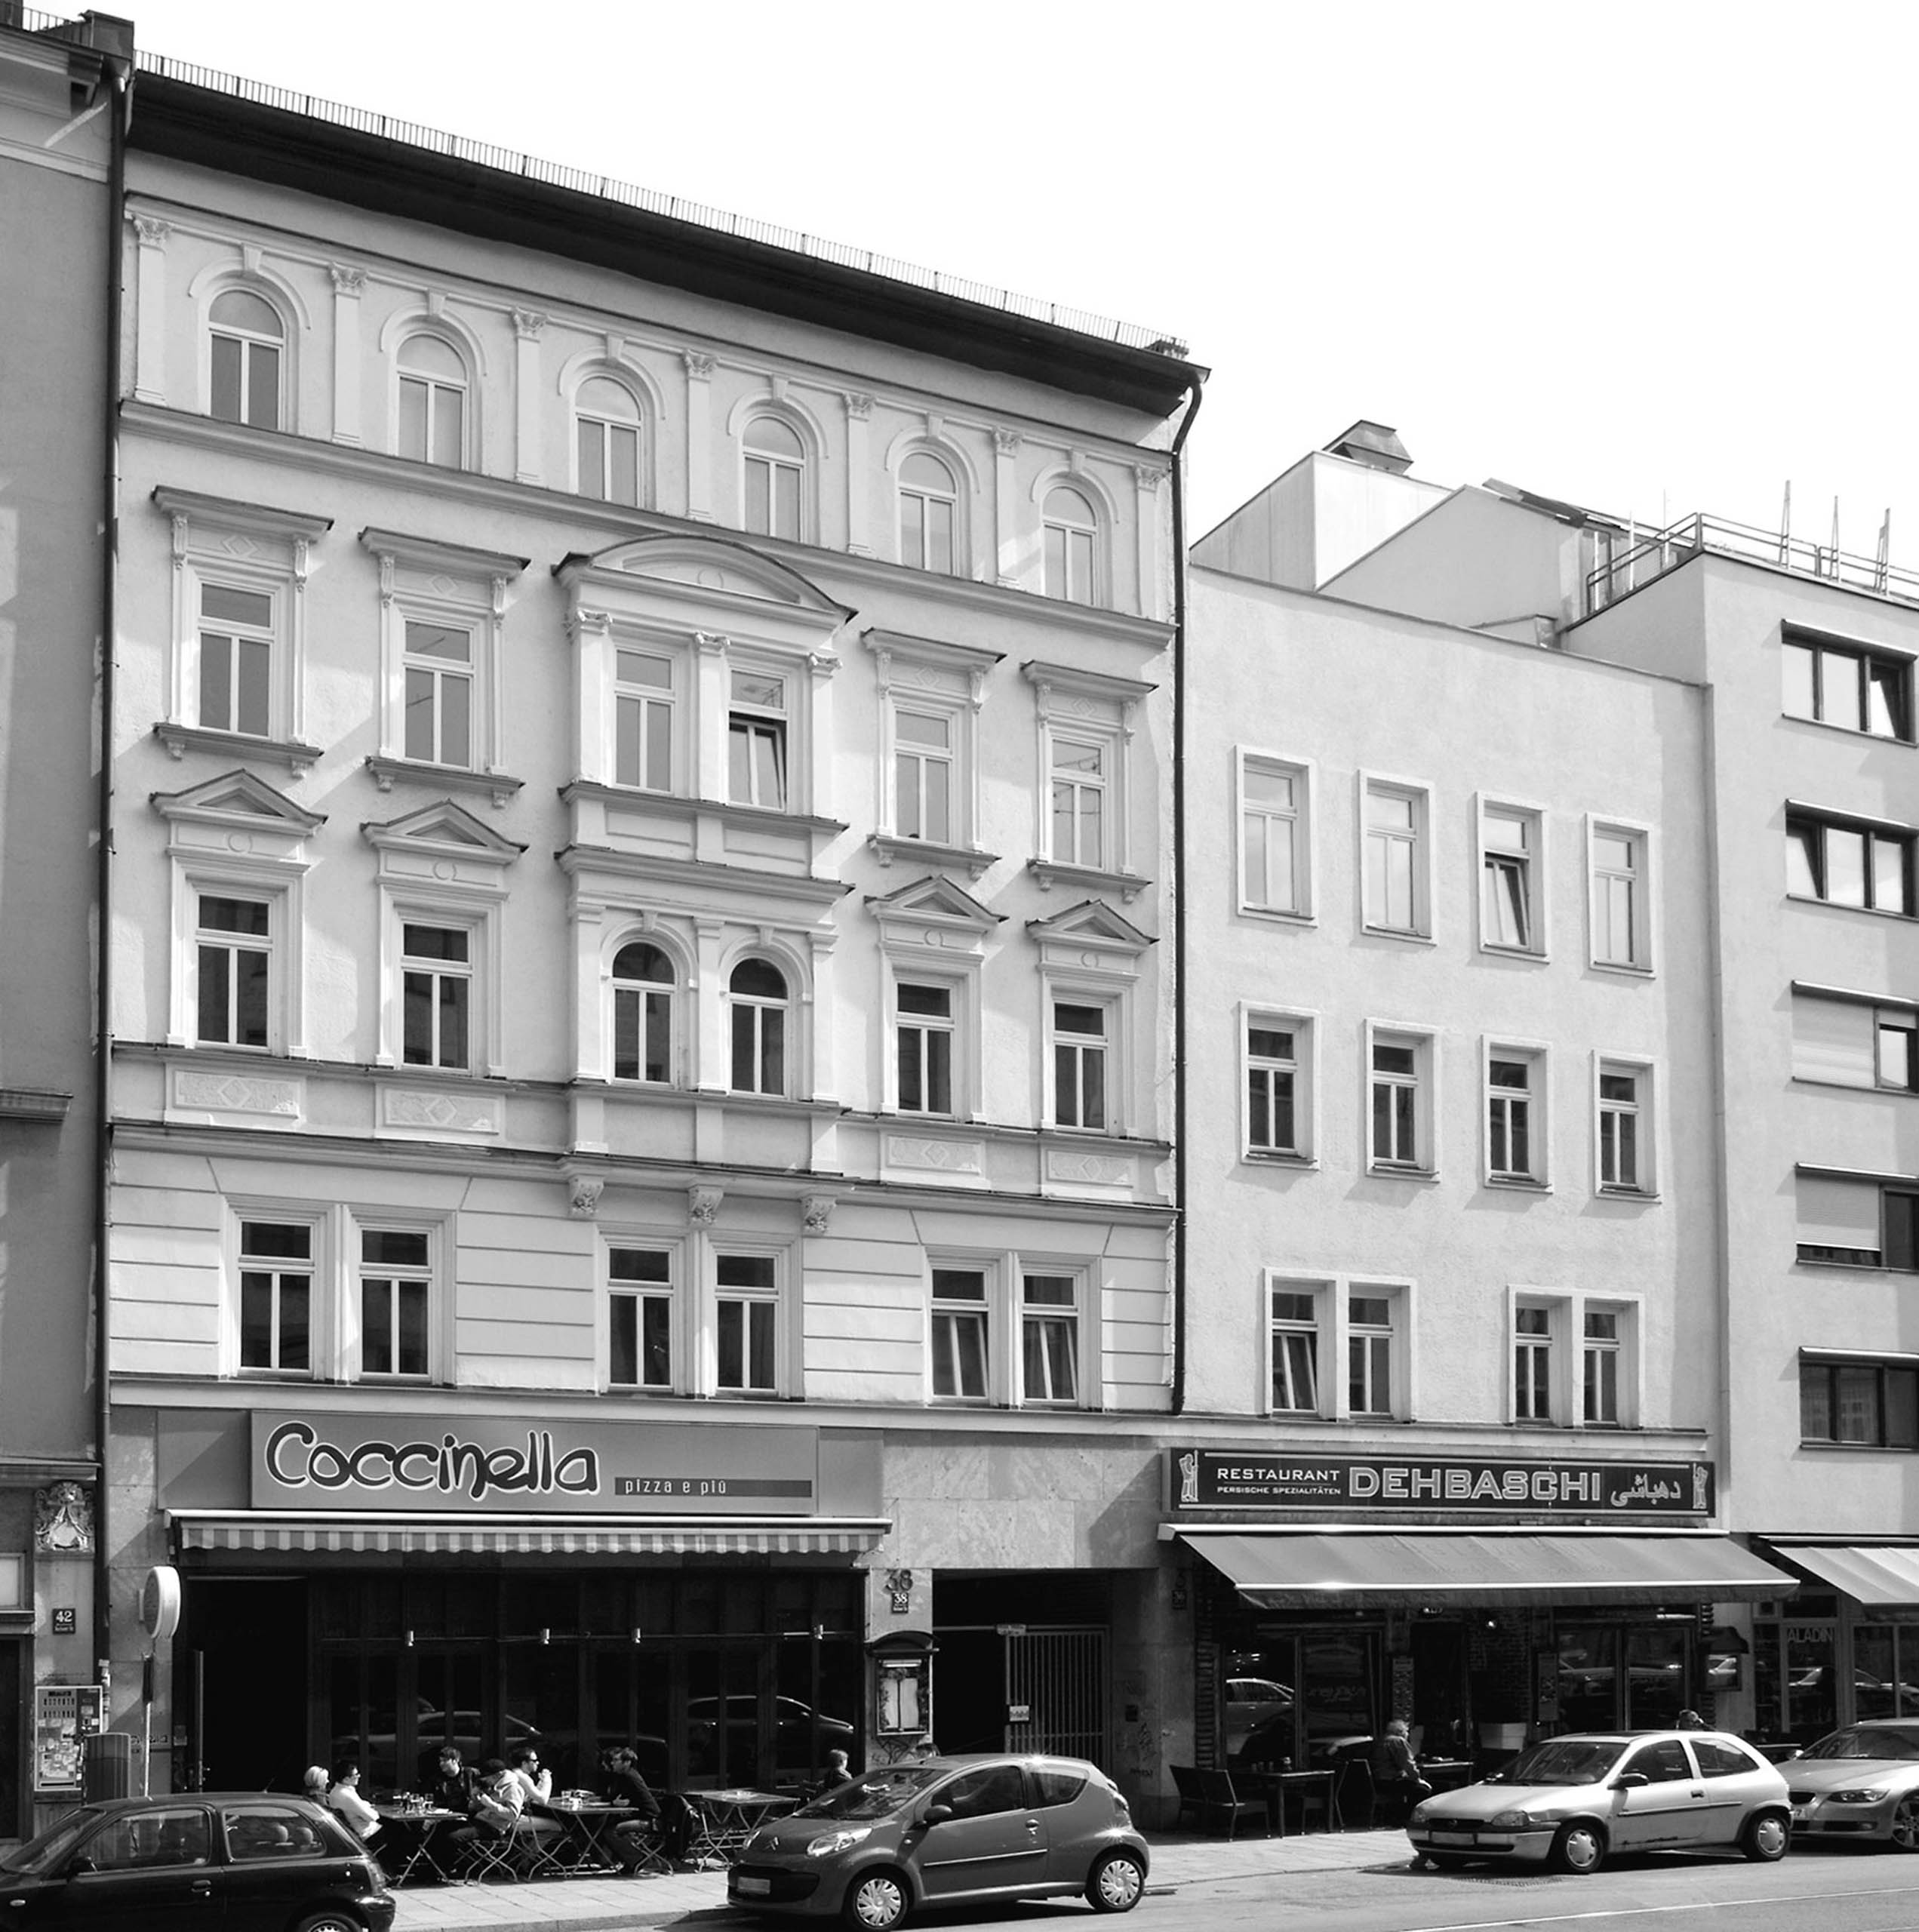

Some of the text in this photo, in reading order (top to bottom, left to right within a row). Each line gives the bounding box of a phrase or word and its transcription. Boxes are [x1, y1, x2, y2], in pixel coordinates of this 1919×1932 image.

[266, 1420, 601, 1500] Coccinella
[1217, 1468, 1340, 1481] RESTAURANT
[625, 1478, 672, 1494] pizza
[682, 1481, 690, 1493] e
[1217, 1485, 1341, 1495] PERSISCHE SPEZIALITÄTEN
[1349, 1466, 1601, 1501] DEHBASCHI
[886, 1569, 913, 1591] 38
[894, 1593, 907, 1603] 38
[56, 1611, 72, 1622] 42
[1788, 1628, 1833, 1642] ALADIN
